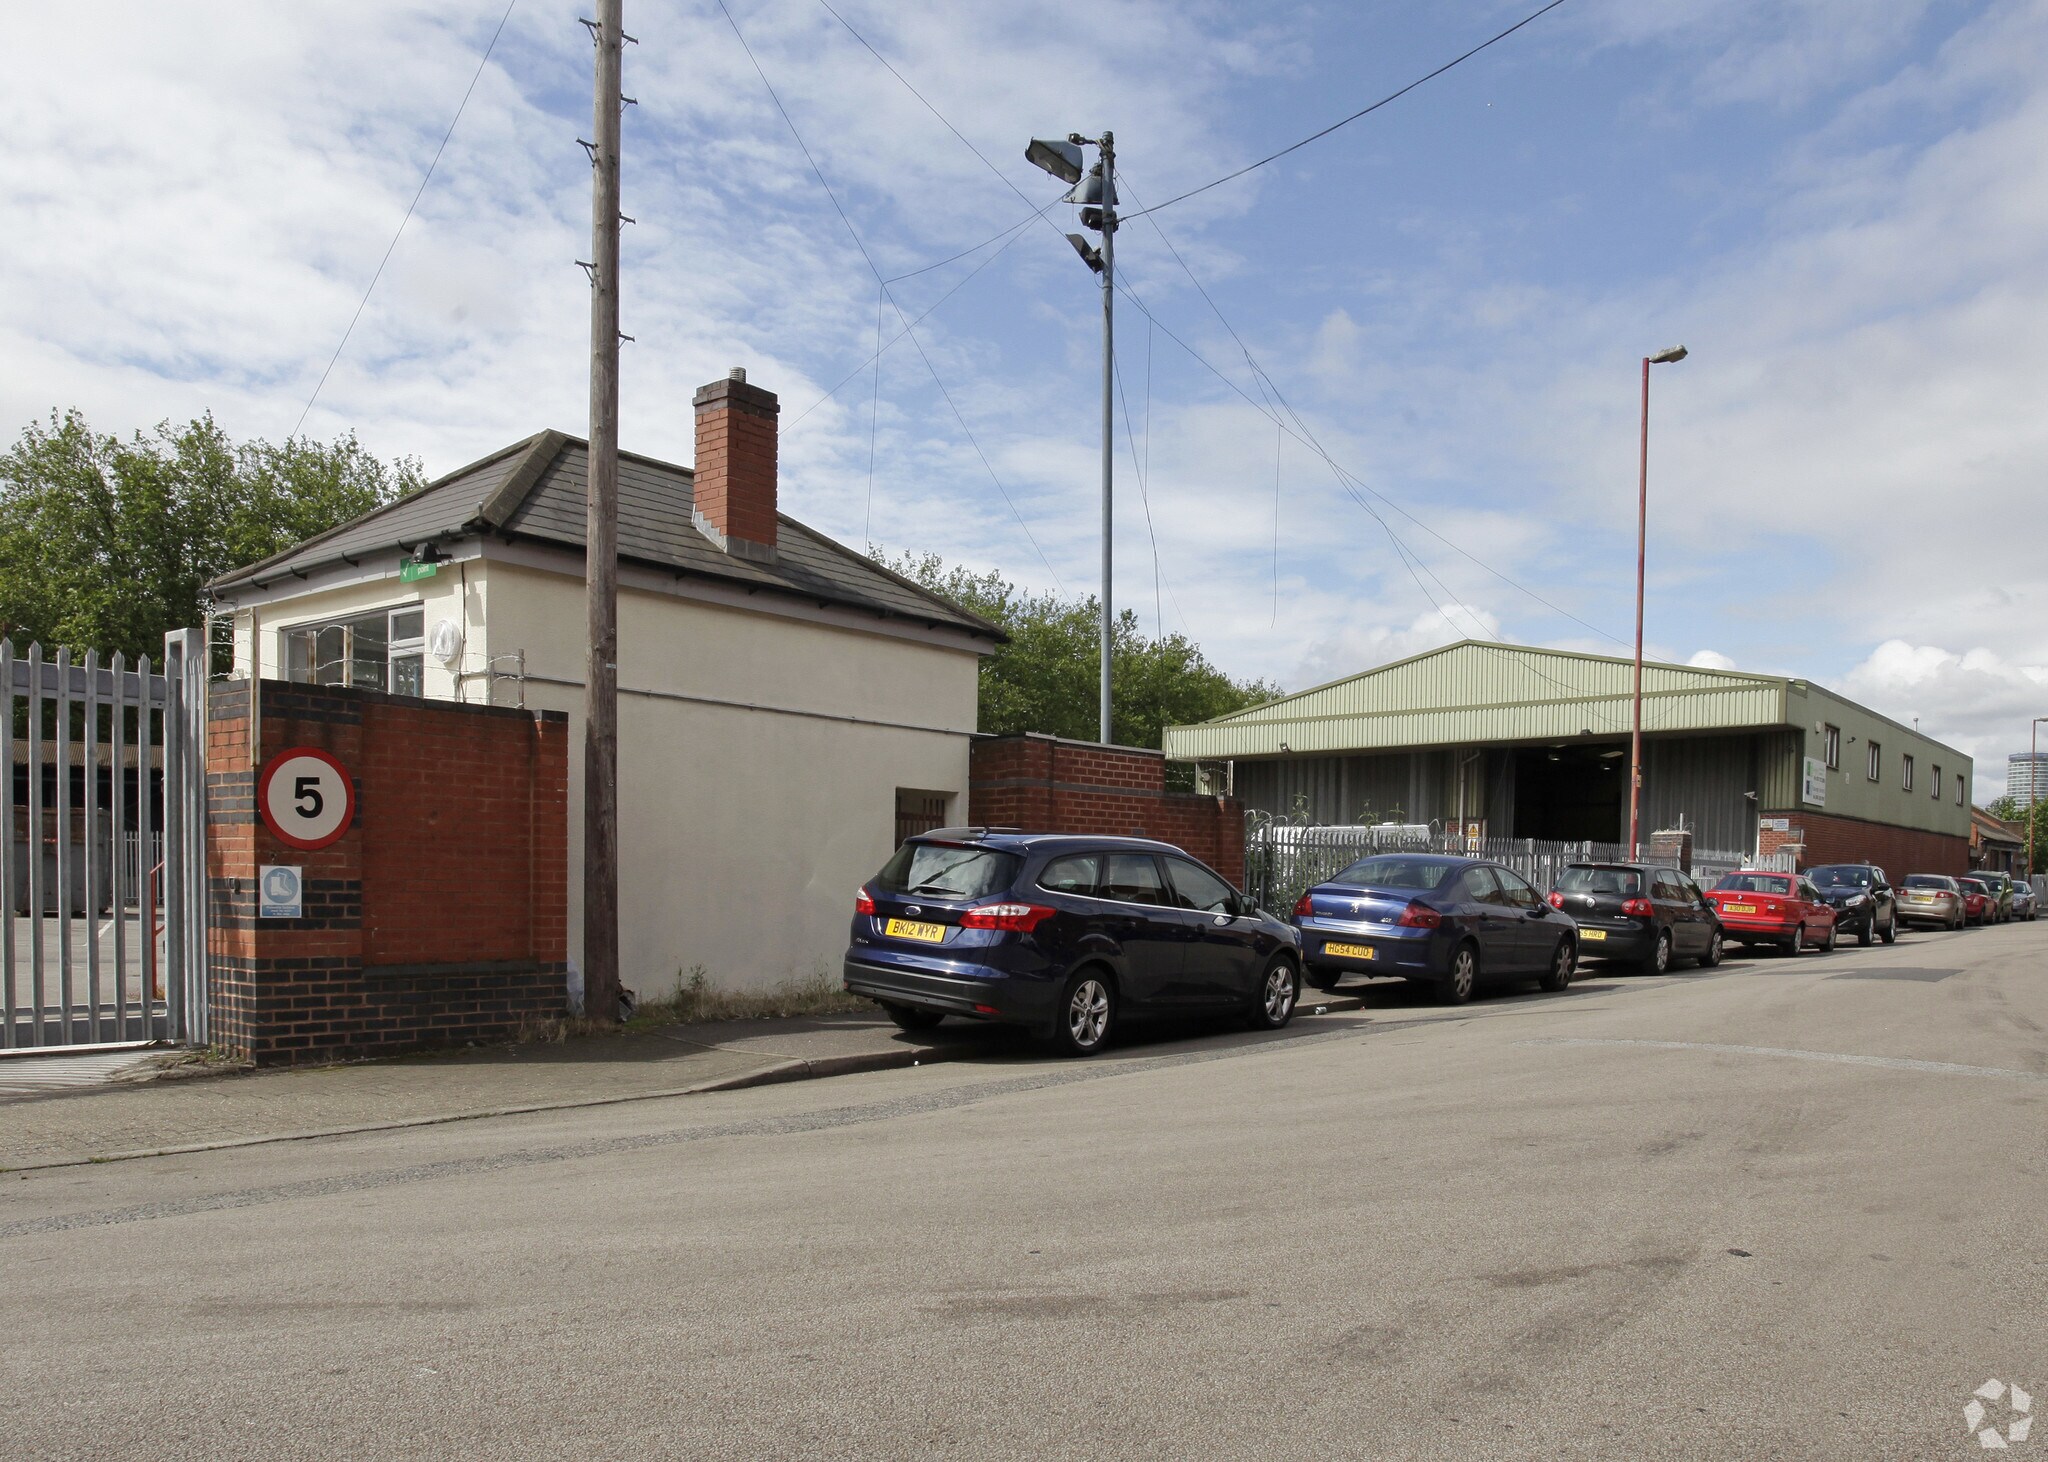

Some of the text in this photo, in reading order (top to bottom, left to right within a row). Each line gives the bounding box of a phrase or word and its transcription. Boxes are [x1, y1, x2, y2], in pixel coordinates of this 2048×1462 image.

[295, 776, 324, 819] 5
[892, 921, 938, 939] BK12 WYR
[1328, 943, 1350, 955] HG54
